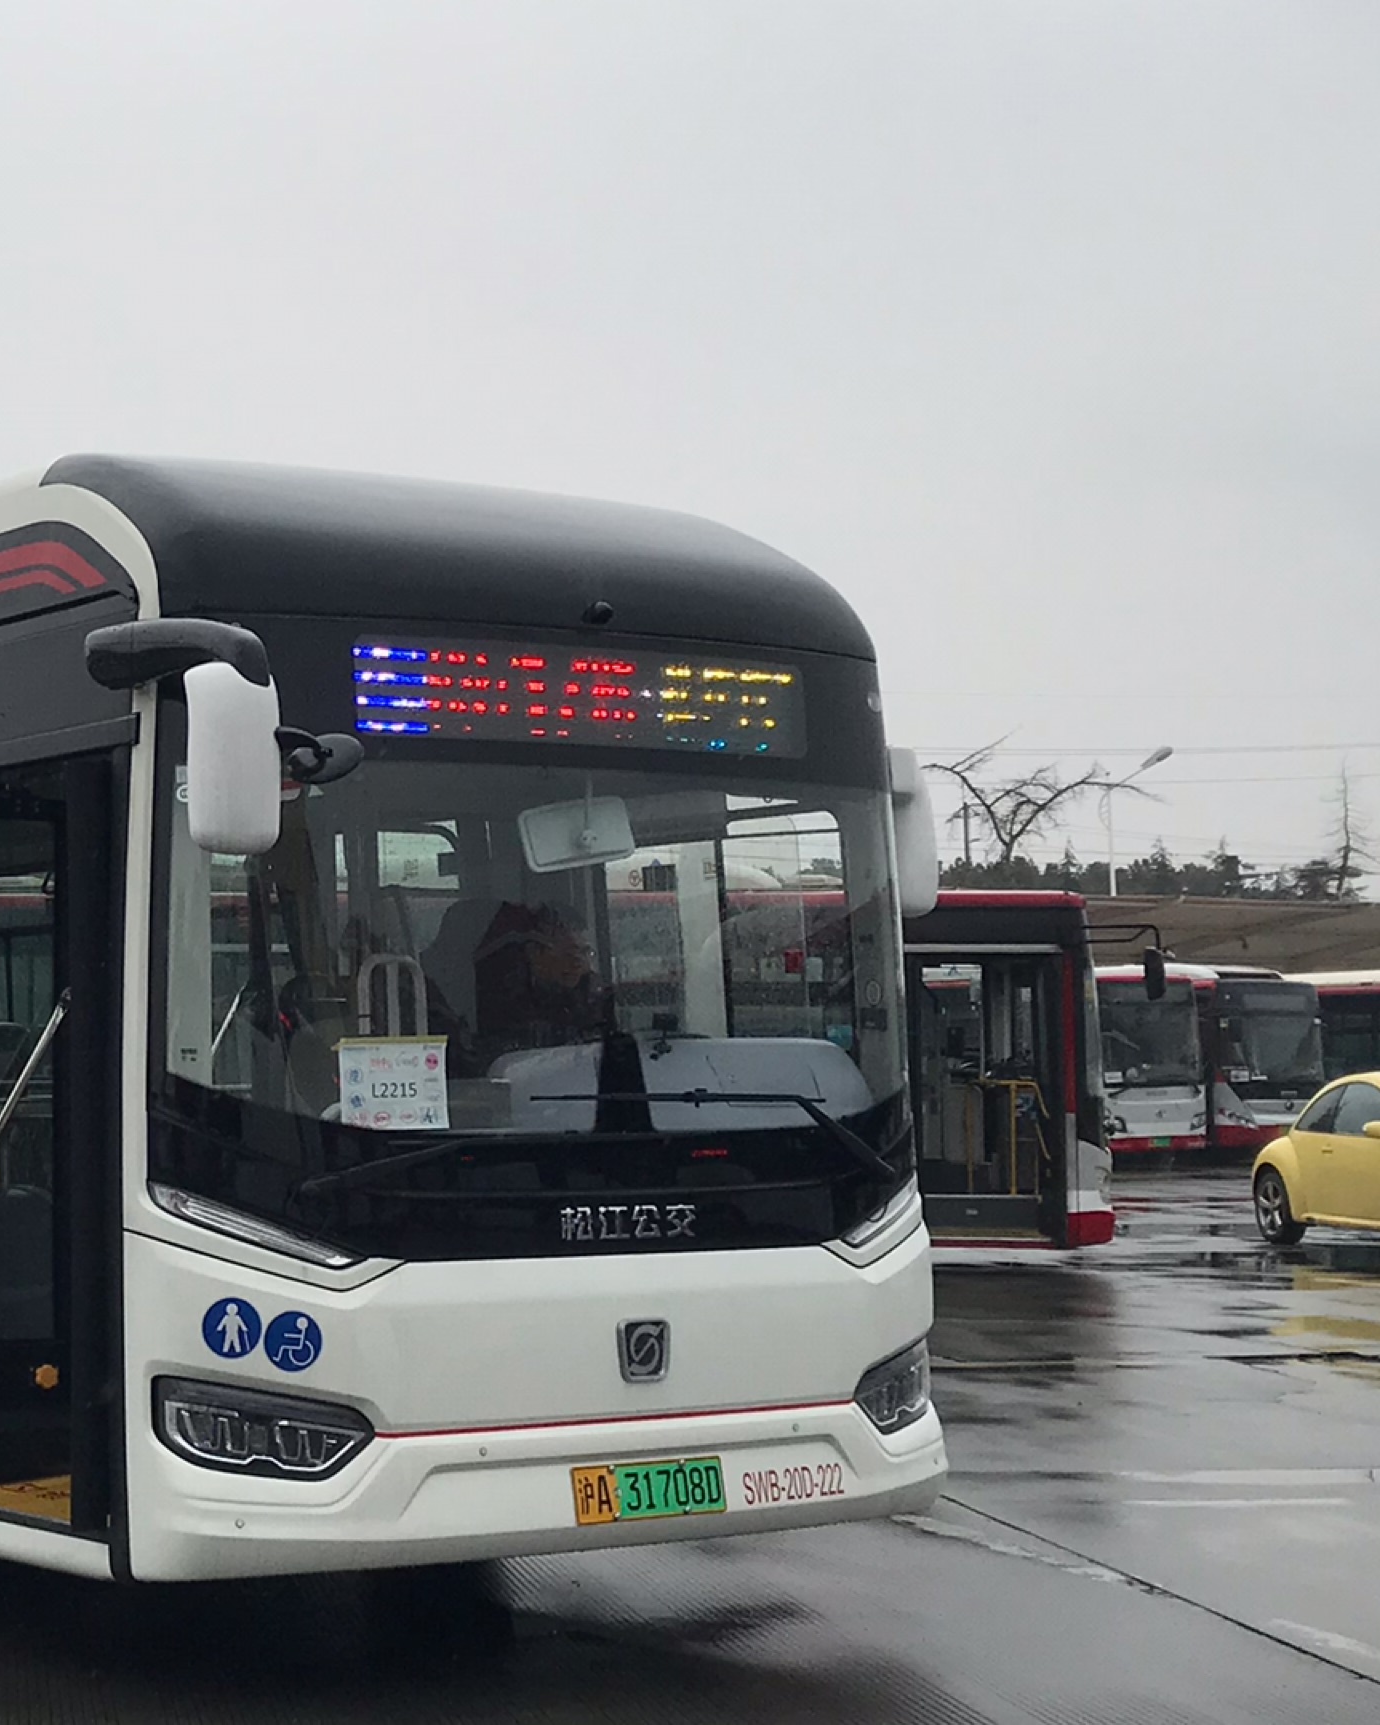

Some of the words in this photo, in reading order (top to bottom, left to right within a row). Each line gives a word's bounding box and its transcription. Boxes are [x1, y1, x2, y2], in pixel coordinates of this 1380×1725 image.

[371, 1081, 418, 1099] L2215
[560, 1203, 697, 1241] 松江公交
[742, 1462, 845, 1506] SWB-20D-222
